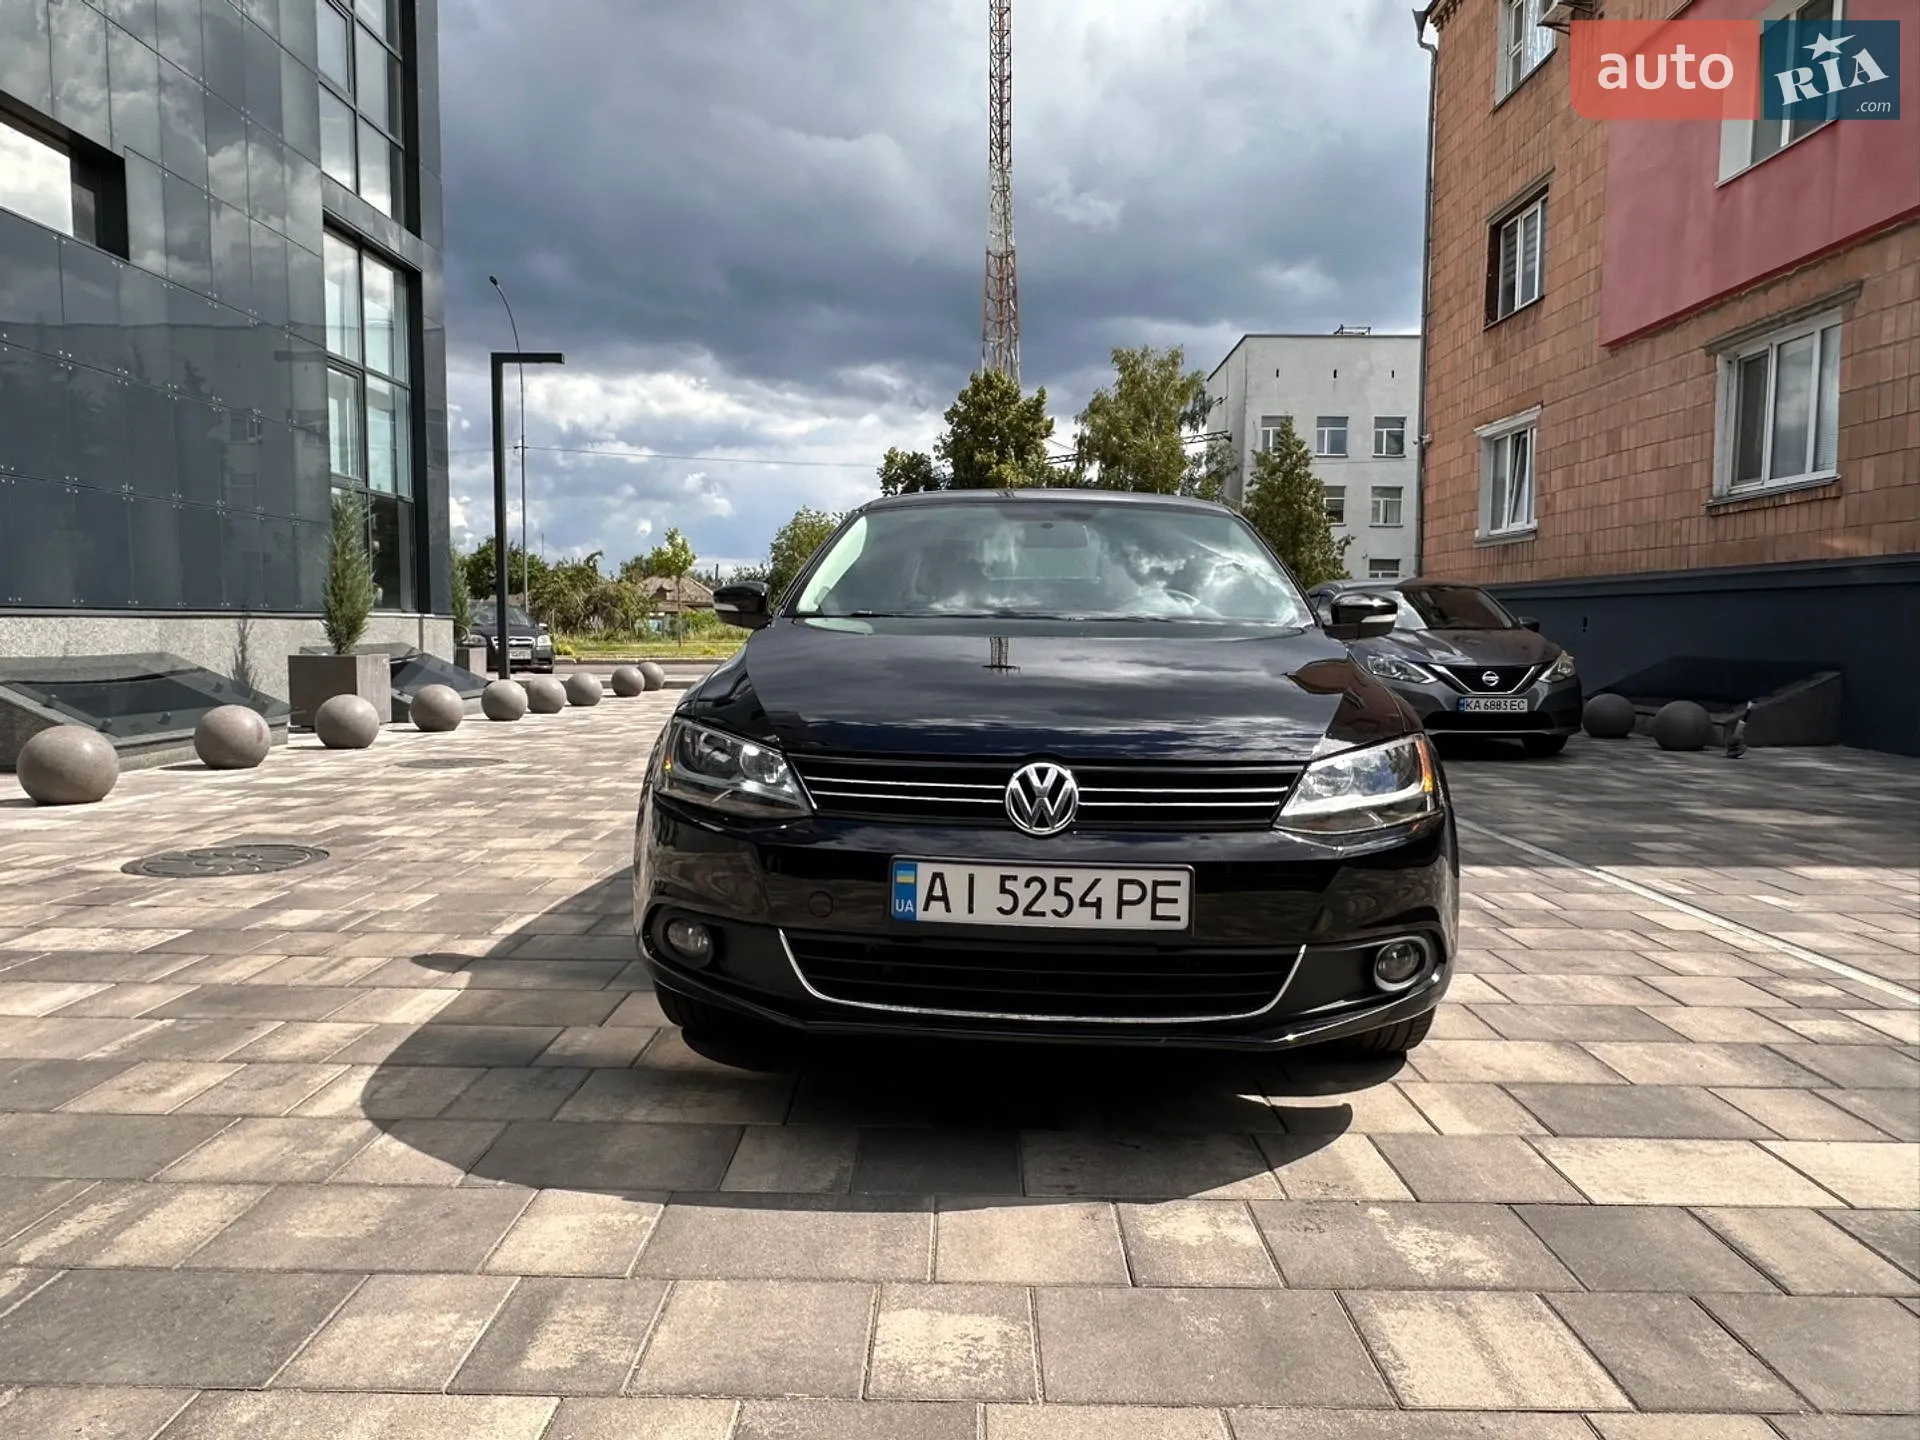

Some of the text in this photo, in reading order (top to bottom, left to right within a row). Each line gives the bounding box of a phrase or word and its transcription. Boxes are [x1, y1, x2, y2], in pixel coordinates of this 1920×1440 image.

[1465, 699, 1481, 711] KA
[1510, 699, 1525, 711] EC
[922, 871, 1181, 922] AI 5254 PE
[895, 899, 914, 913] UA
